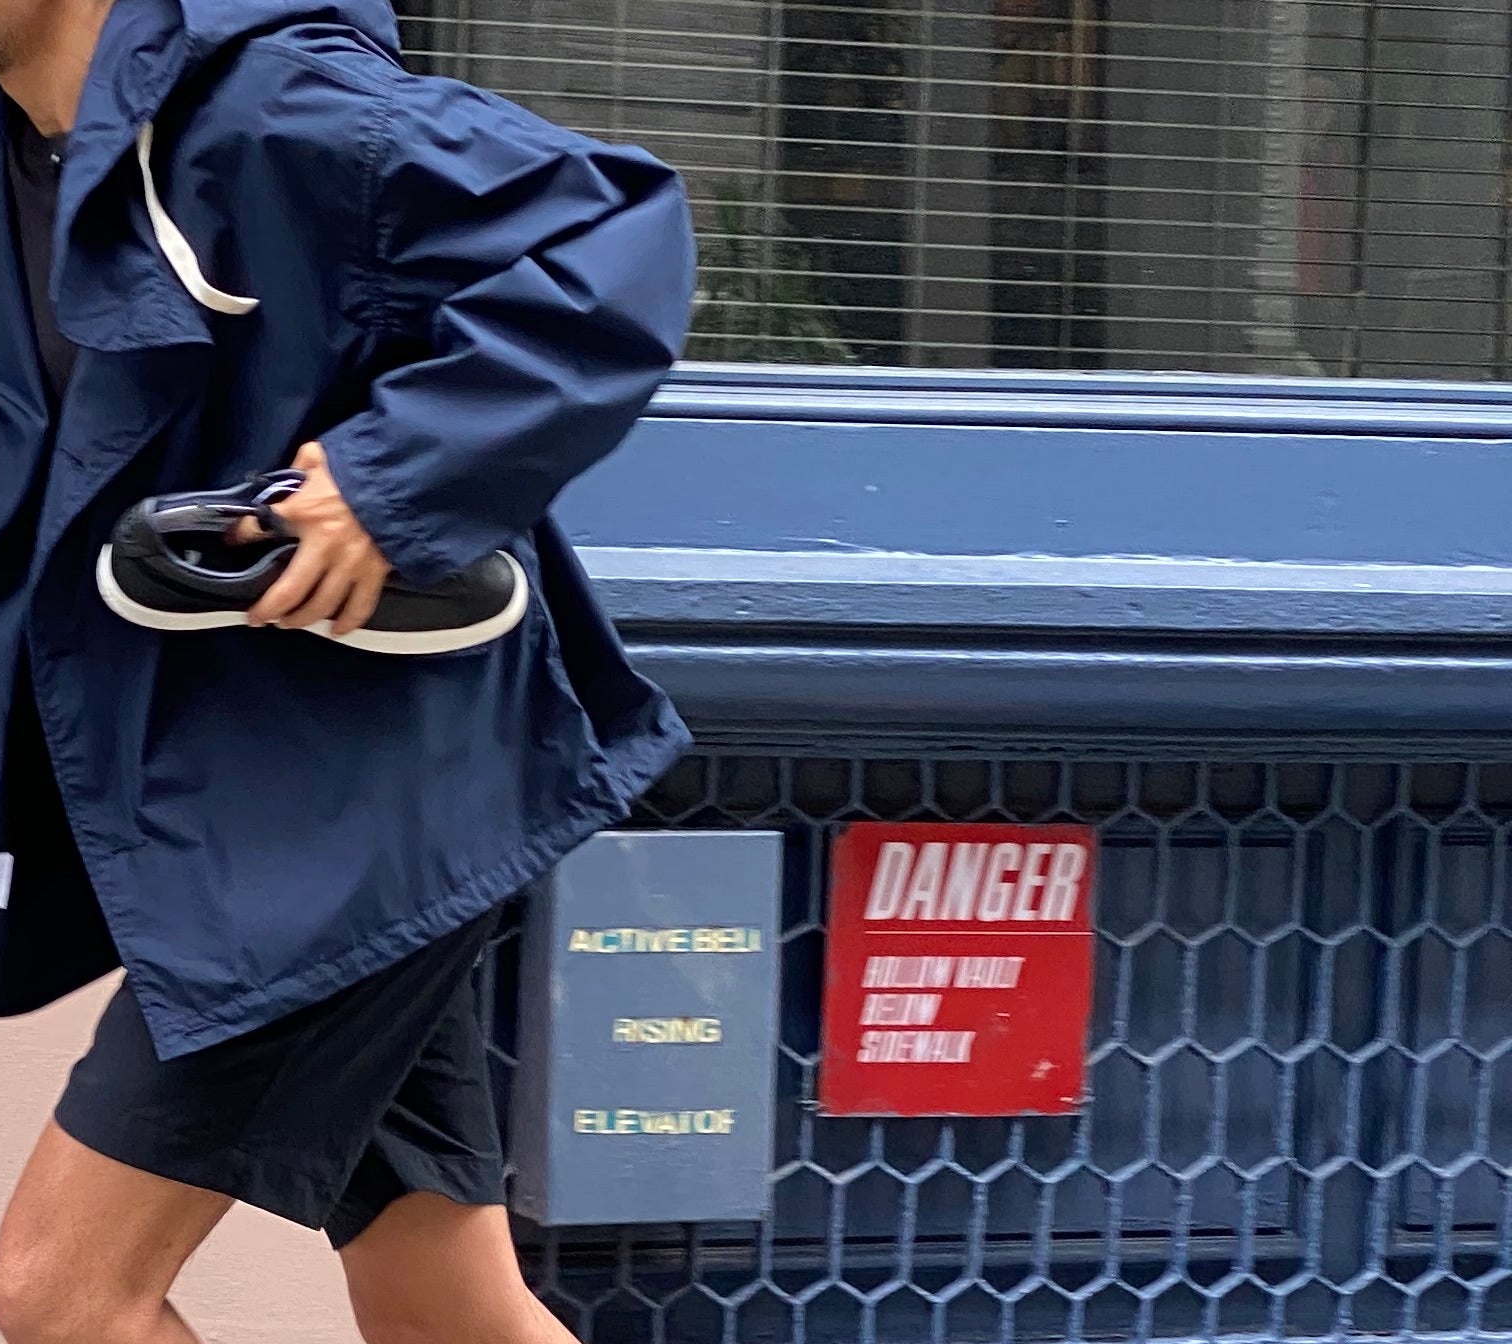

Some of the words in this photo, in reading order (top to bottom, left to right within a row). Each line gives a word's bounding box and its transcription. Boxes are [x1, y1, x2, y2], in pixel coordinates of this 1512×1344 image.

[863, 840, 1089, 921] DANGER
[568, 927, 691, 954] ACTIVE
[612, 1018, 722, 1044] RISING
